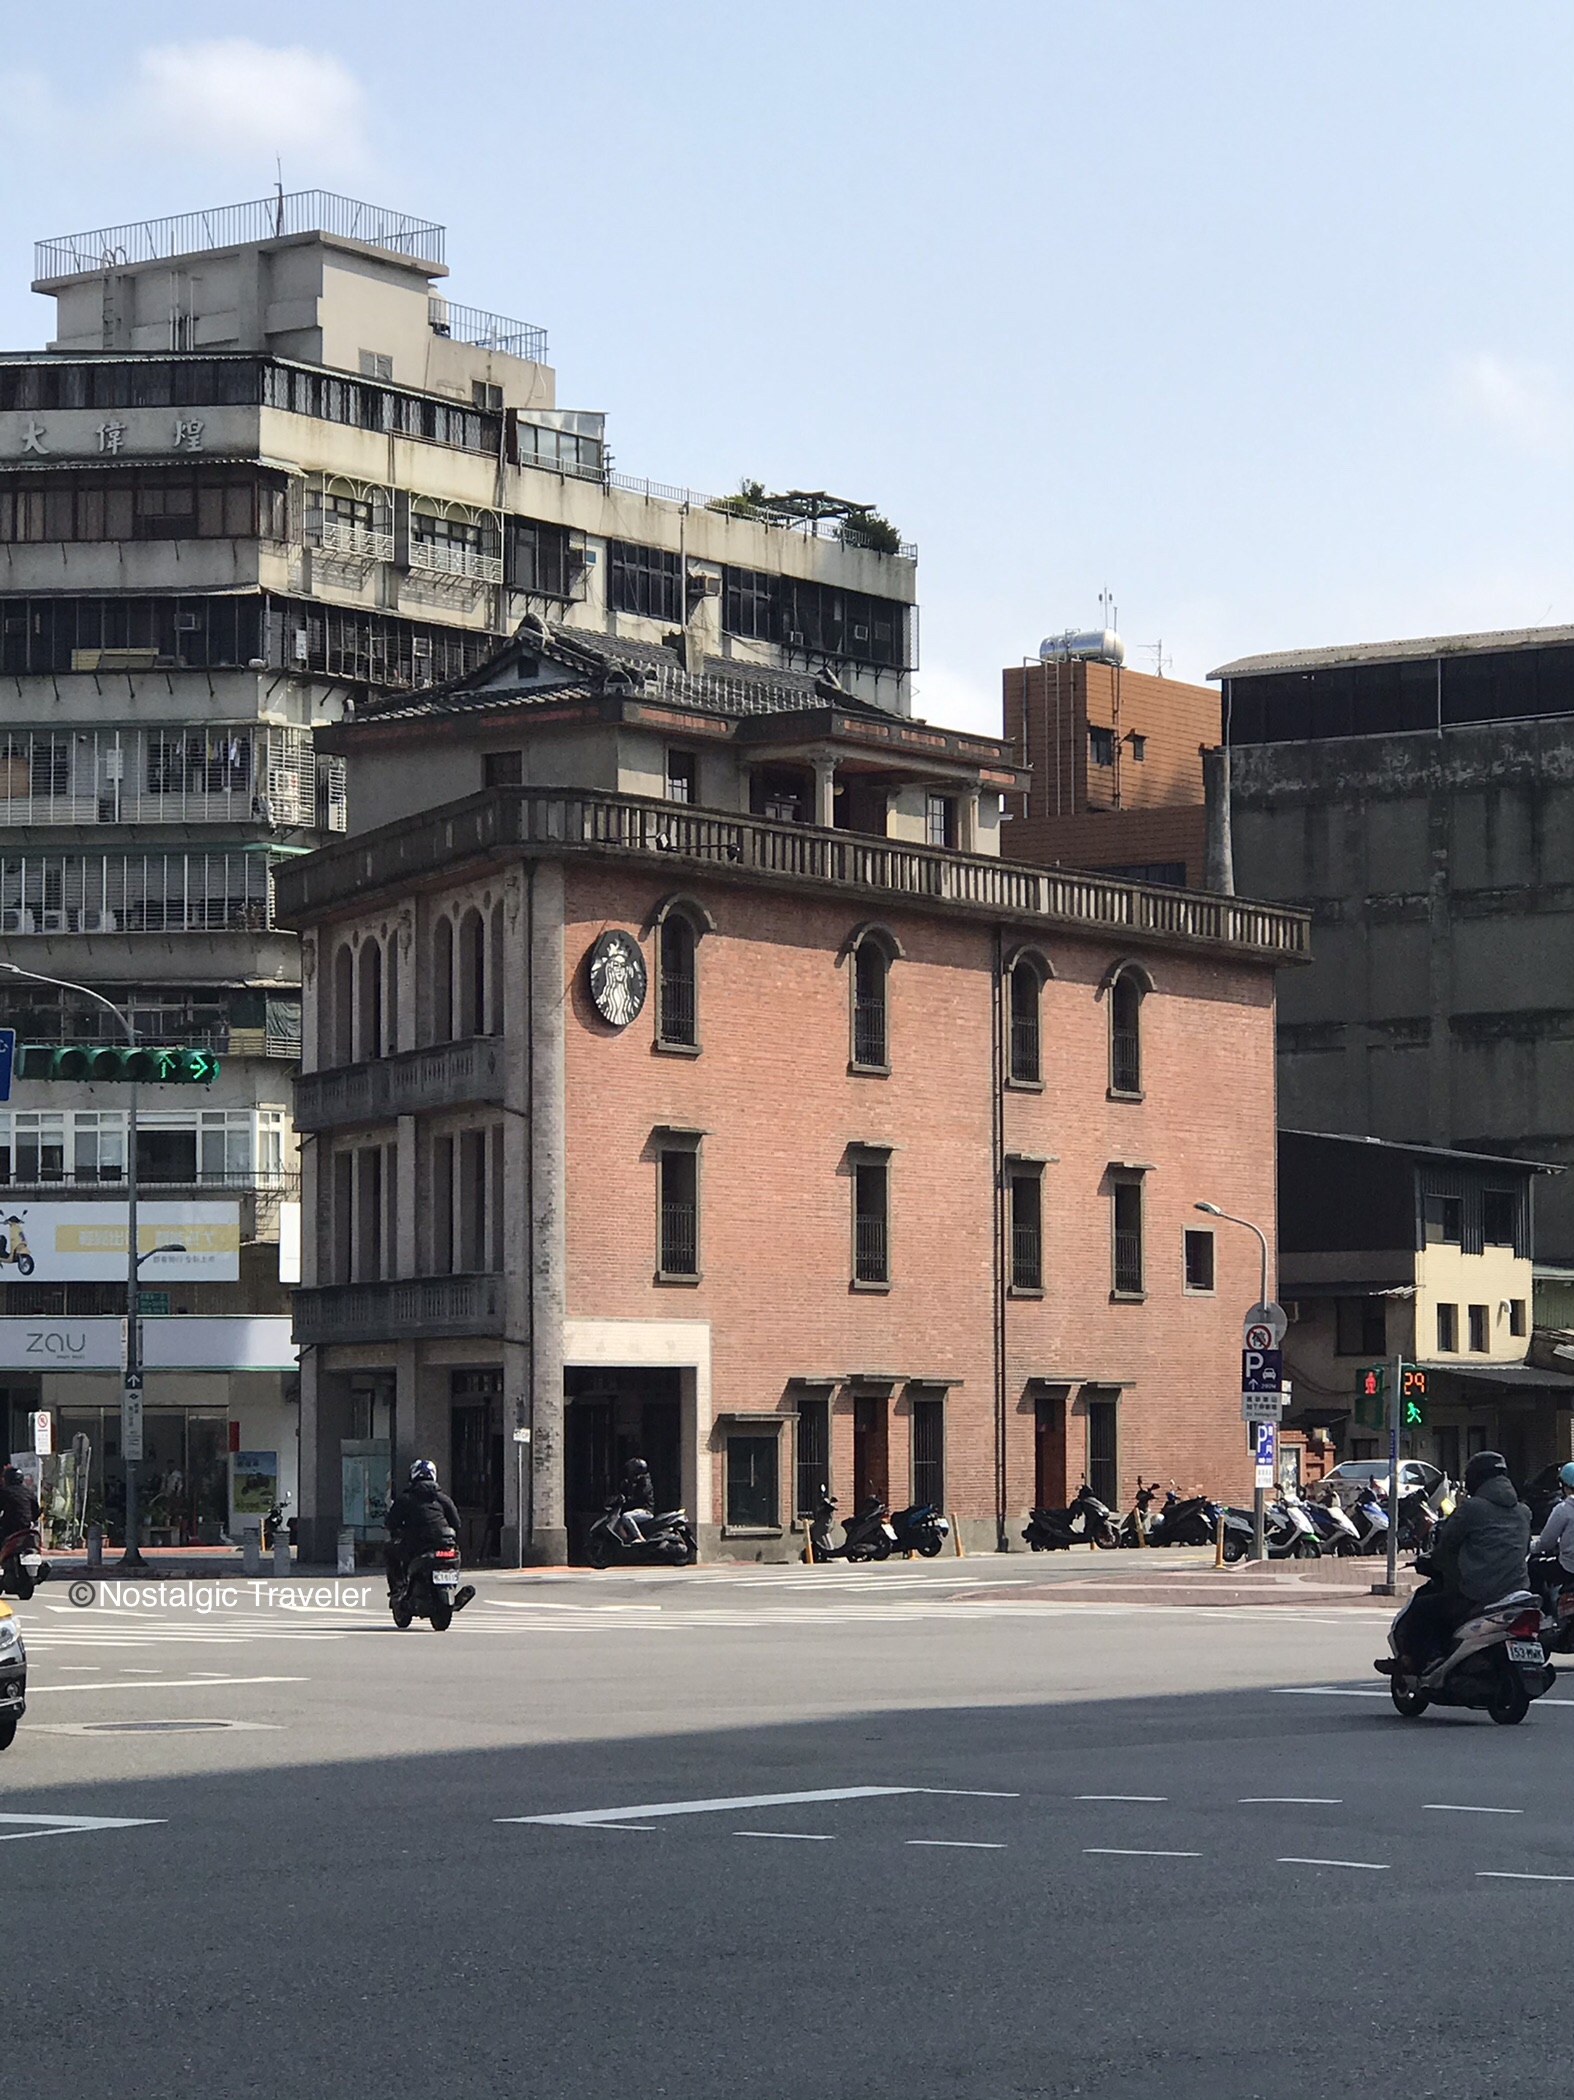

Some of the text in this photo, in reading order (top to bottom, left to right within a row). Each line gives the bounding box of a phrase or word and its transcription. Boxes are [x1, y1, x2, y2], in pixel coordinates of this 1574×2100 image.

[1245, 1351, 1264, 1378] P
[1404, 1372, 1425, 1396] 29
[1257, 1425, 1268, 1454] P
